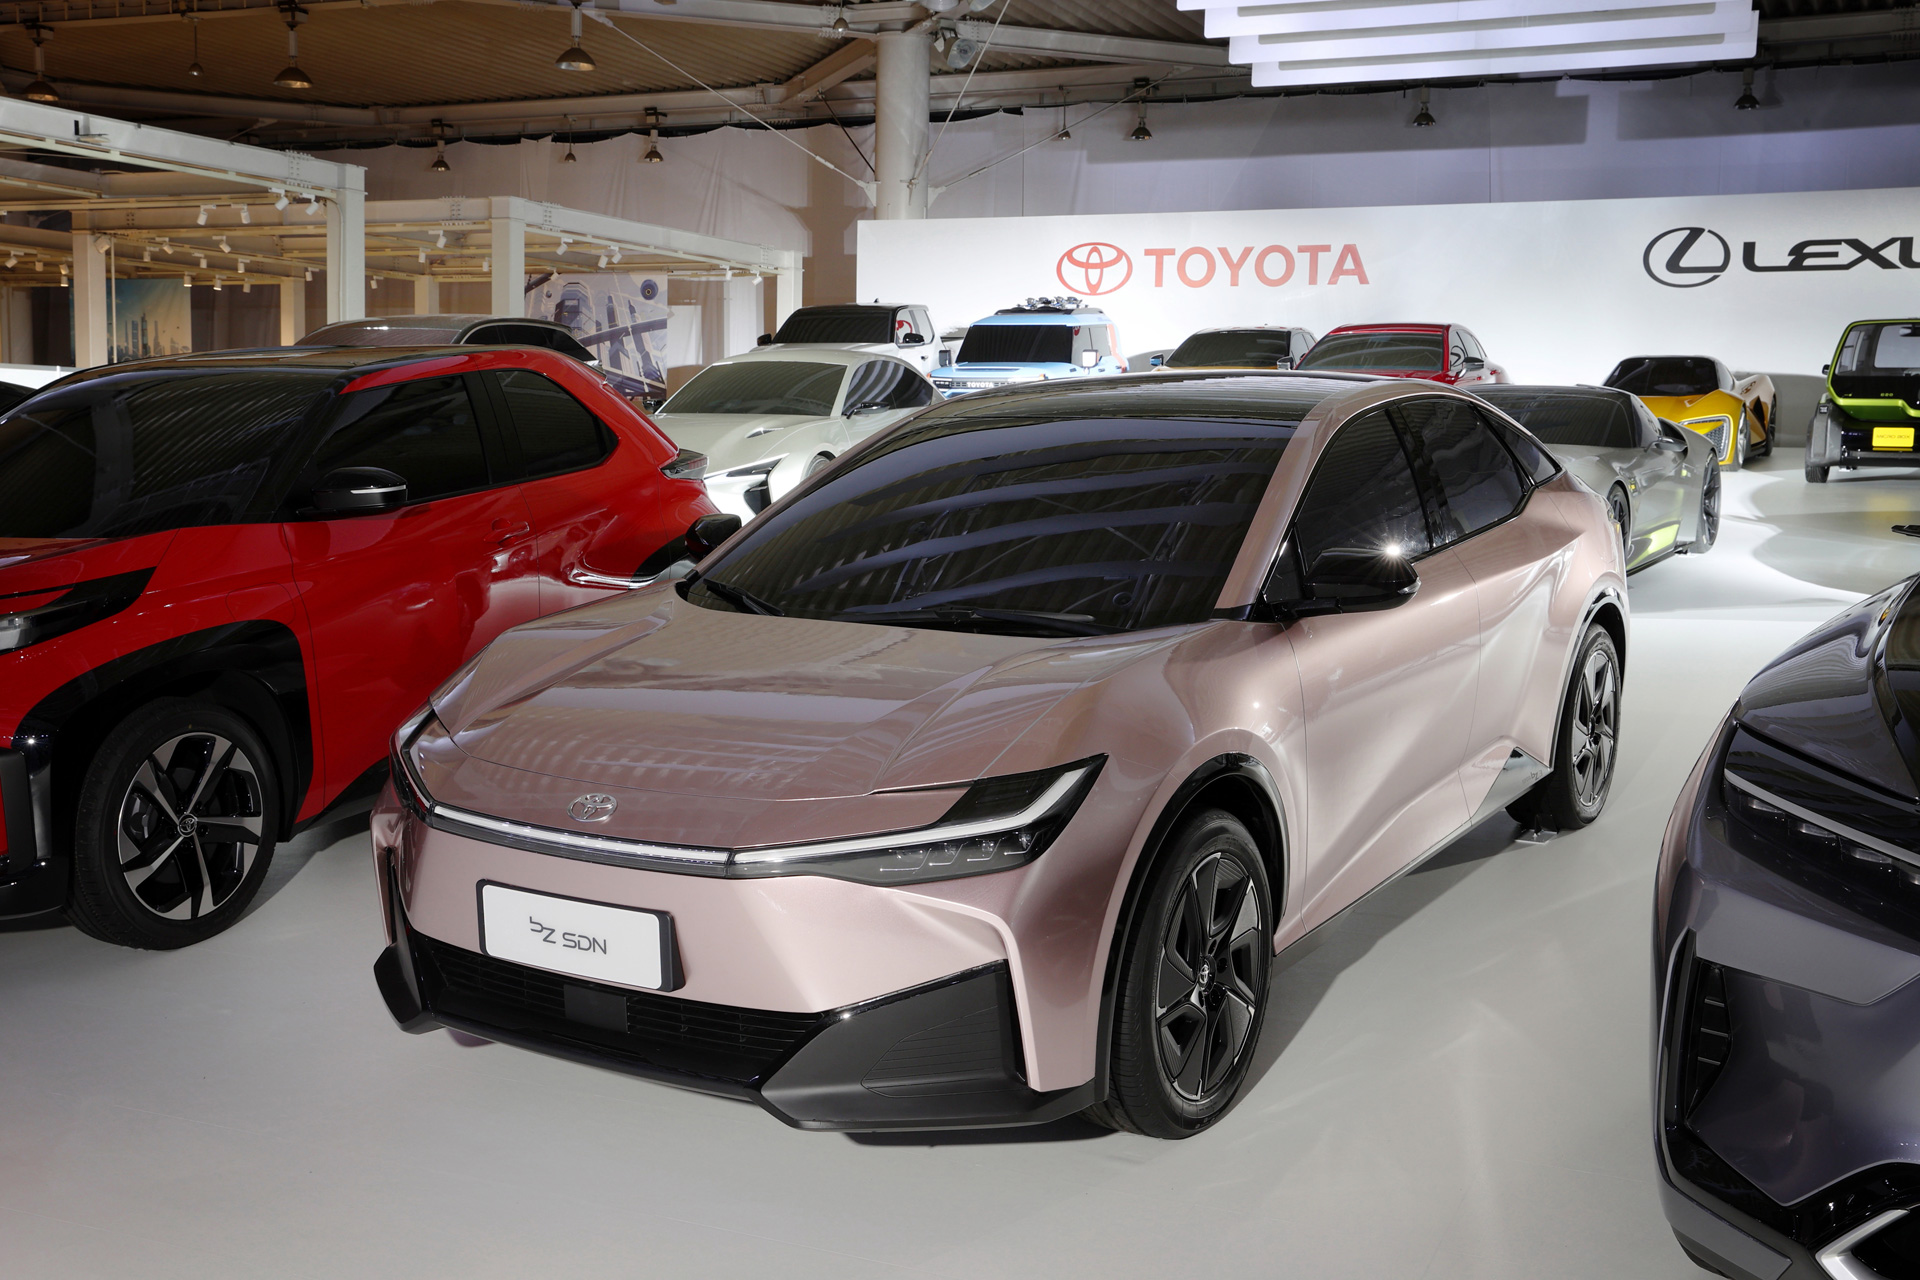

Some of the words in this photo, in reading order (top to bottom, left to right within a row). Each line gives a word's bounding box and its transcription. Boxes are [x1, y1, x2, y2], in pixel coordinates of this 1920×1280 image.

[1143, 243, 1370, 289] TOYOTA
[529, 916, 557, 944] bZ
[562, 932, 607, 955] SDN
